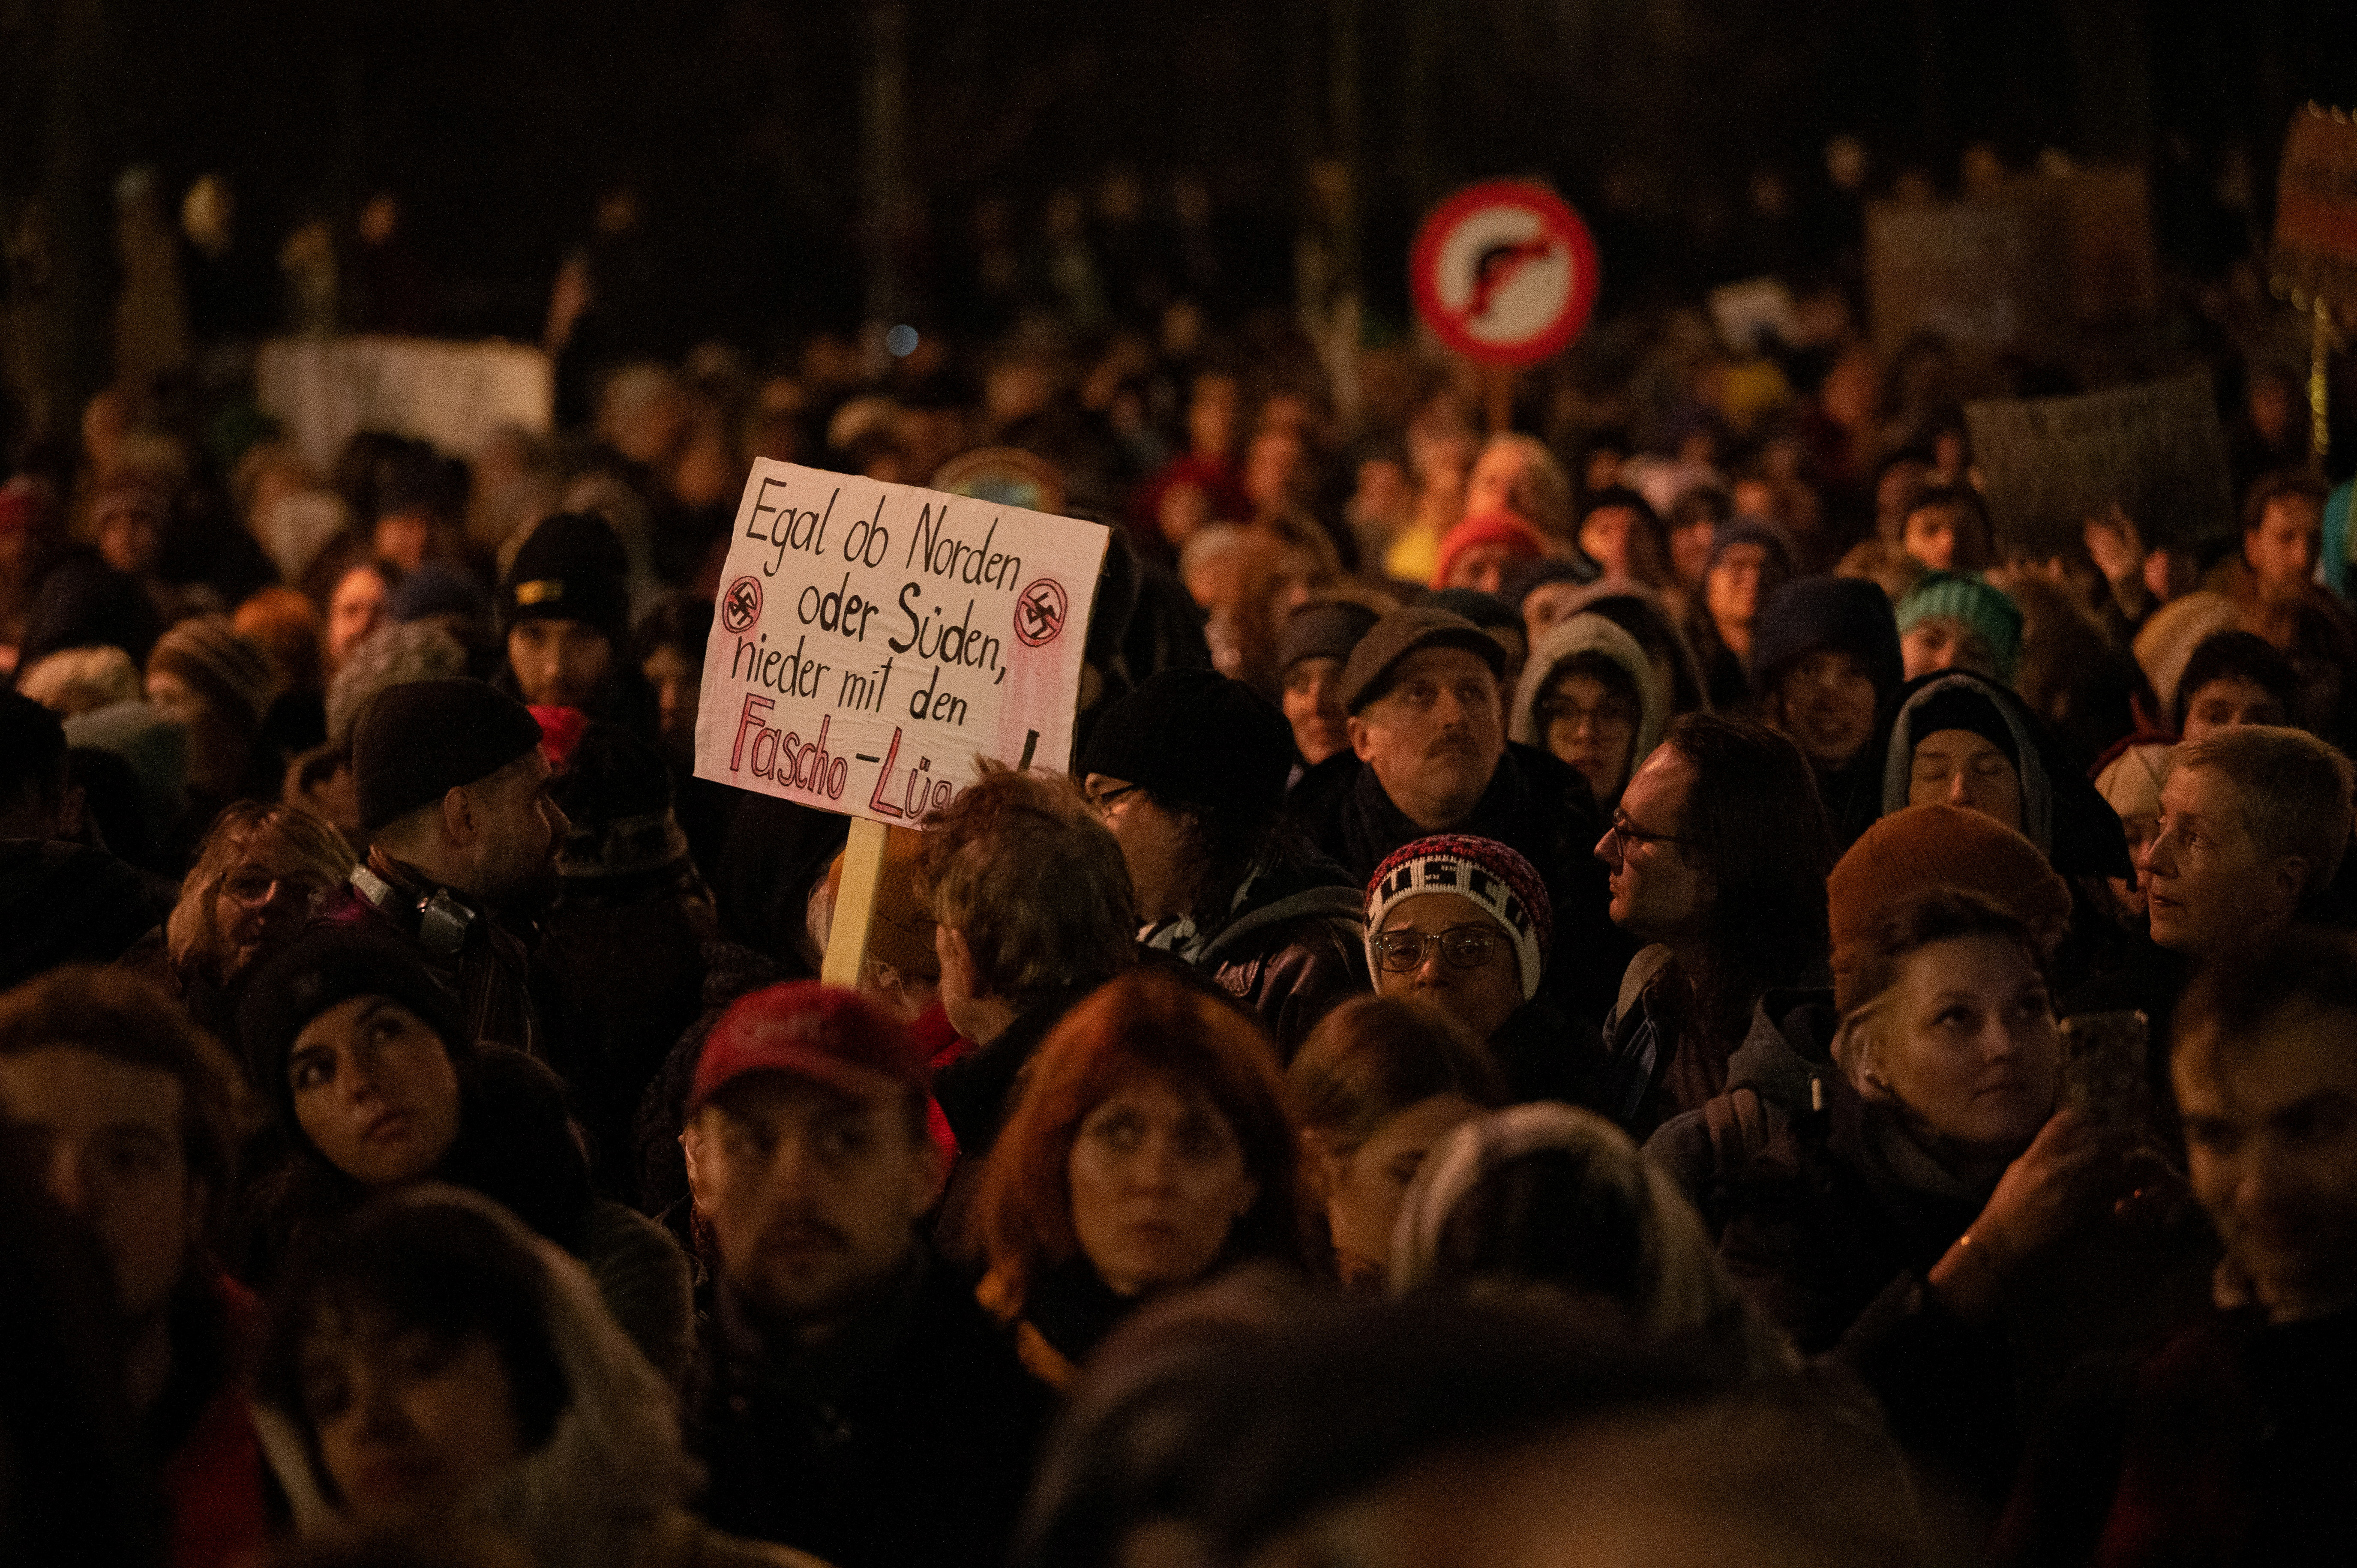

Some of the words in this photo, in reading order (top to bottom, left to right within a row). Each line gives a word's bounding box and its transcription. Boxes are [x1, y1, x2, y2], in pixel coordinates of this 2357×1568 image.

[745, 477, 840, 577] Egal
[844, 495, 889, 568] ob
[906, 502, 1022, 591] Norden
[731, 633, 830, 699] nieder
[838, 657, 893, 713] mit
[909, 666, 968, 726] den
[798, 572, 879, 642] oder
[888, 582, 1007, 685] Süden,
